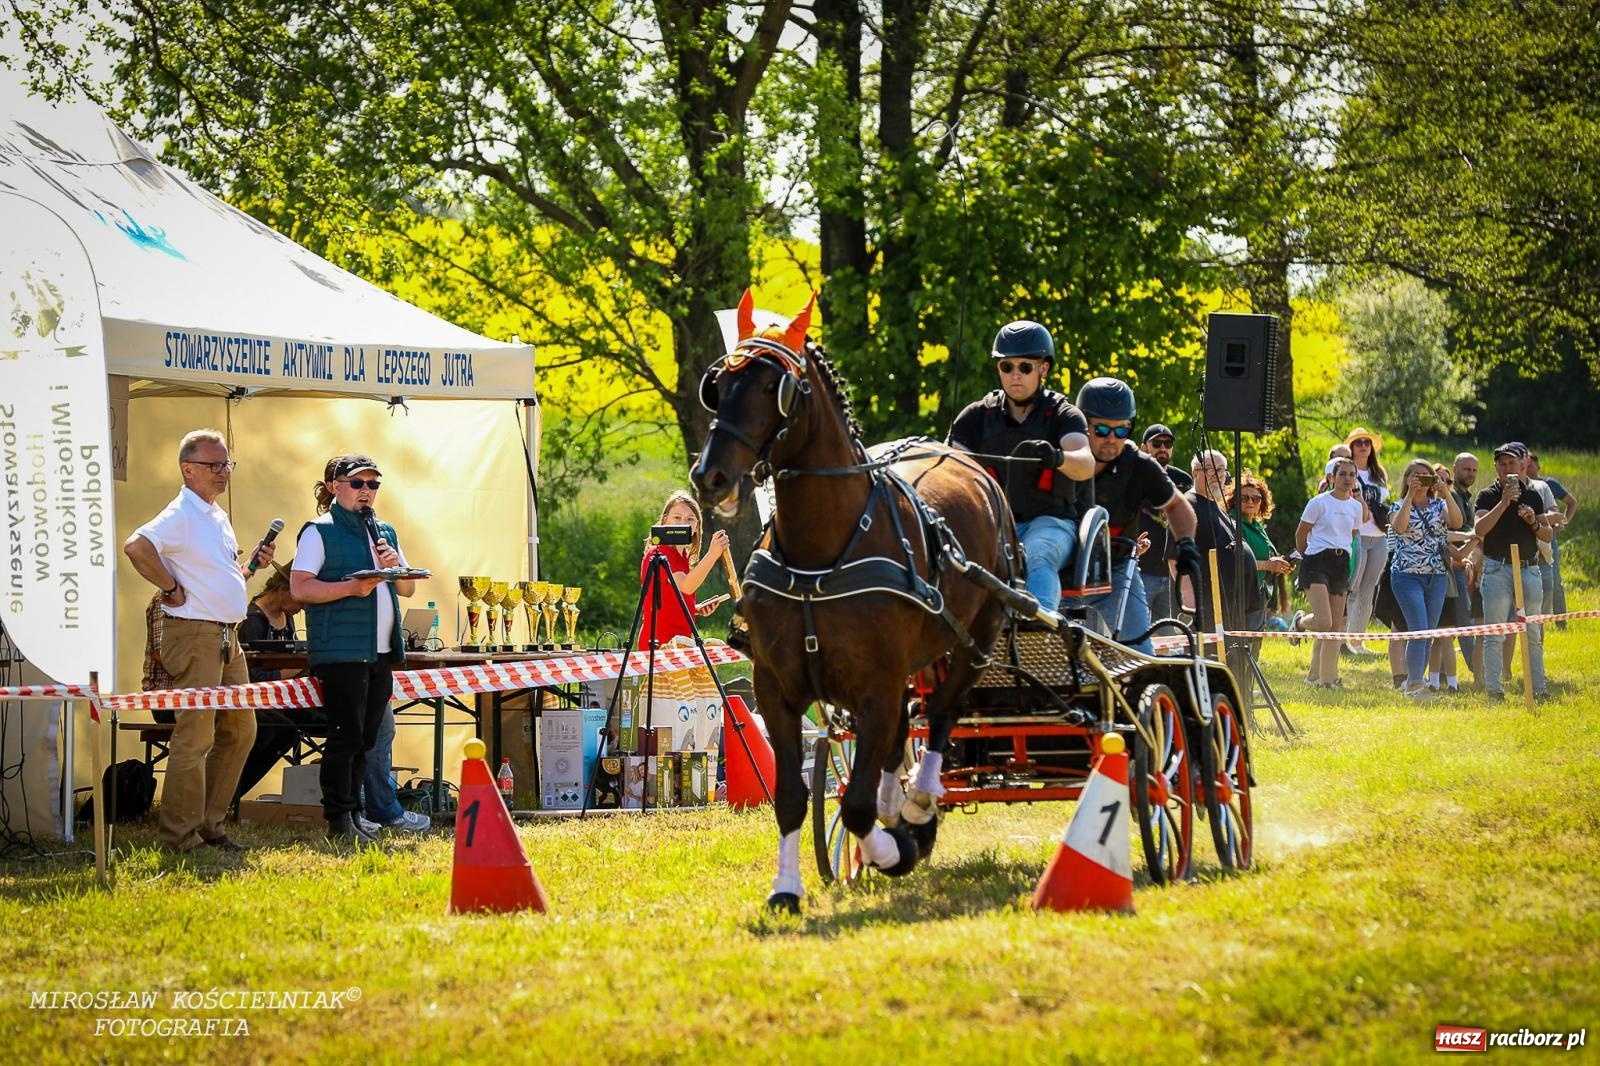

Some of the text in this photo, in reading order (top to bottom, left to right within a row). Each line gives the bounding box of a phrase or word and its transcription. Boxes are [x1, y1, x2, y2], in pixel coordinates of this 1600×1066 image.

[164, 332, 475, 387] STOWARZYSZENIE AKTYWNI DLA LEPSZEGO JUTRA
[463, 801, 480, 848] 1
[1098, 801, 1120, 845] 1
